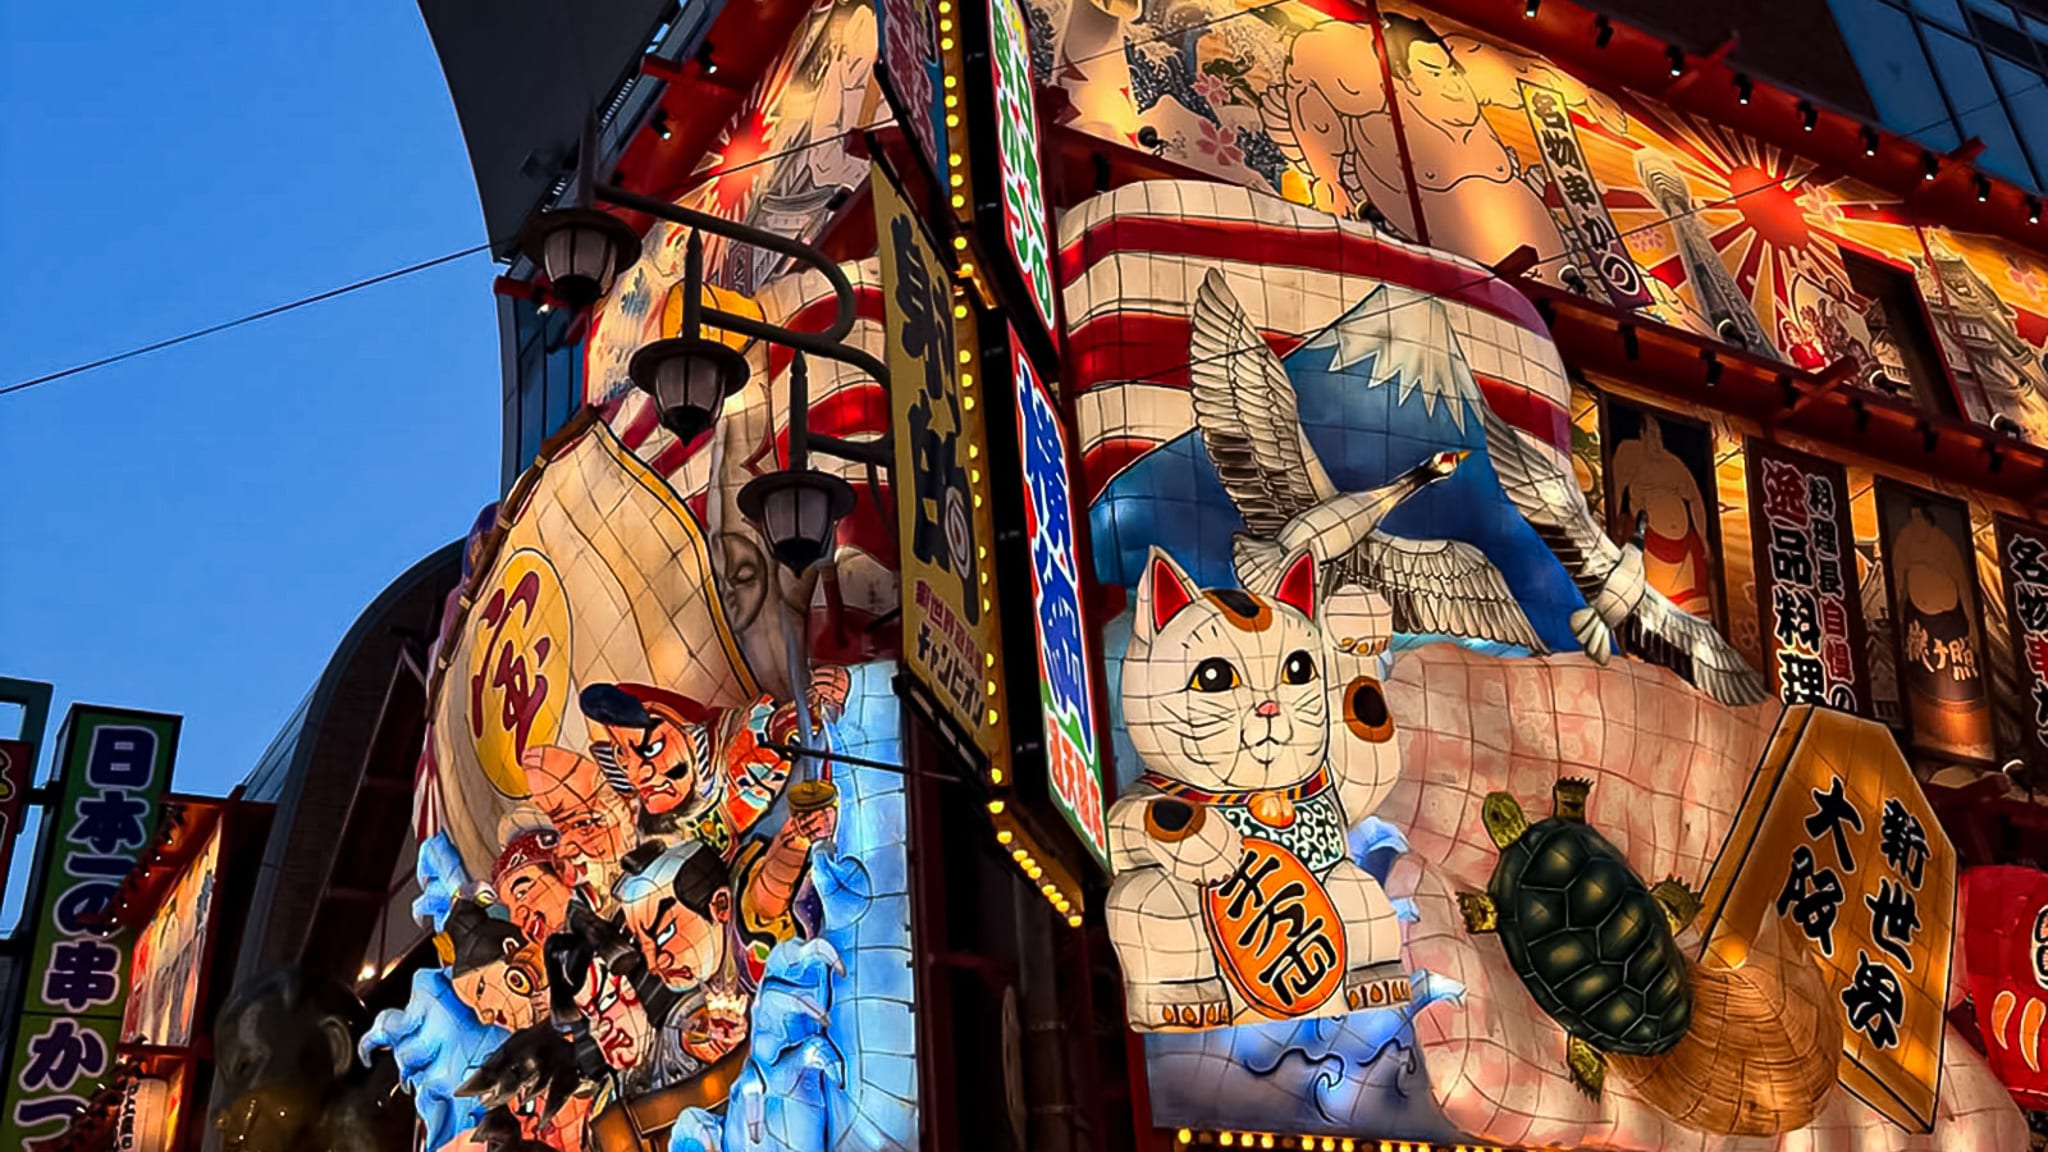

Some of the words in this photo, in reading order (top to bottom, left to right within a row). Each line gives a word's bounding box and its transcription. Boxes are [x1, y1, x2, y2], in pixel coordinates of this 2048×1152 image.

[1531, 92, 1641, 296] 名物串かつ
[890, 216, 980, 626] 射的
[1017, 351, 1095, 765] 横綱
[916, 621, 985, 730] チャンピオン
[1776, 775, 1864, 957] 大阪
[1842, 797, 1932, 1050] 新世界
